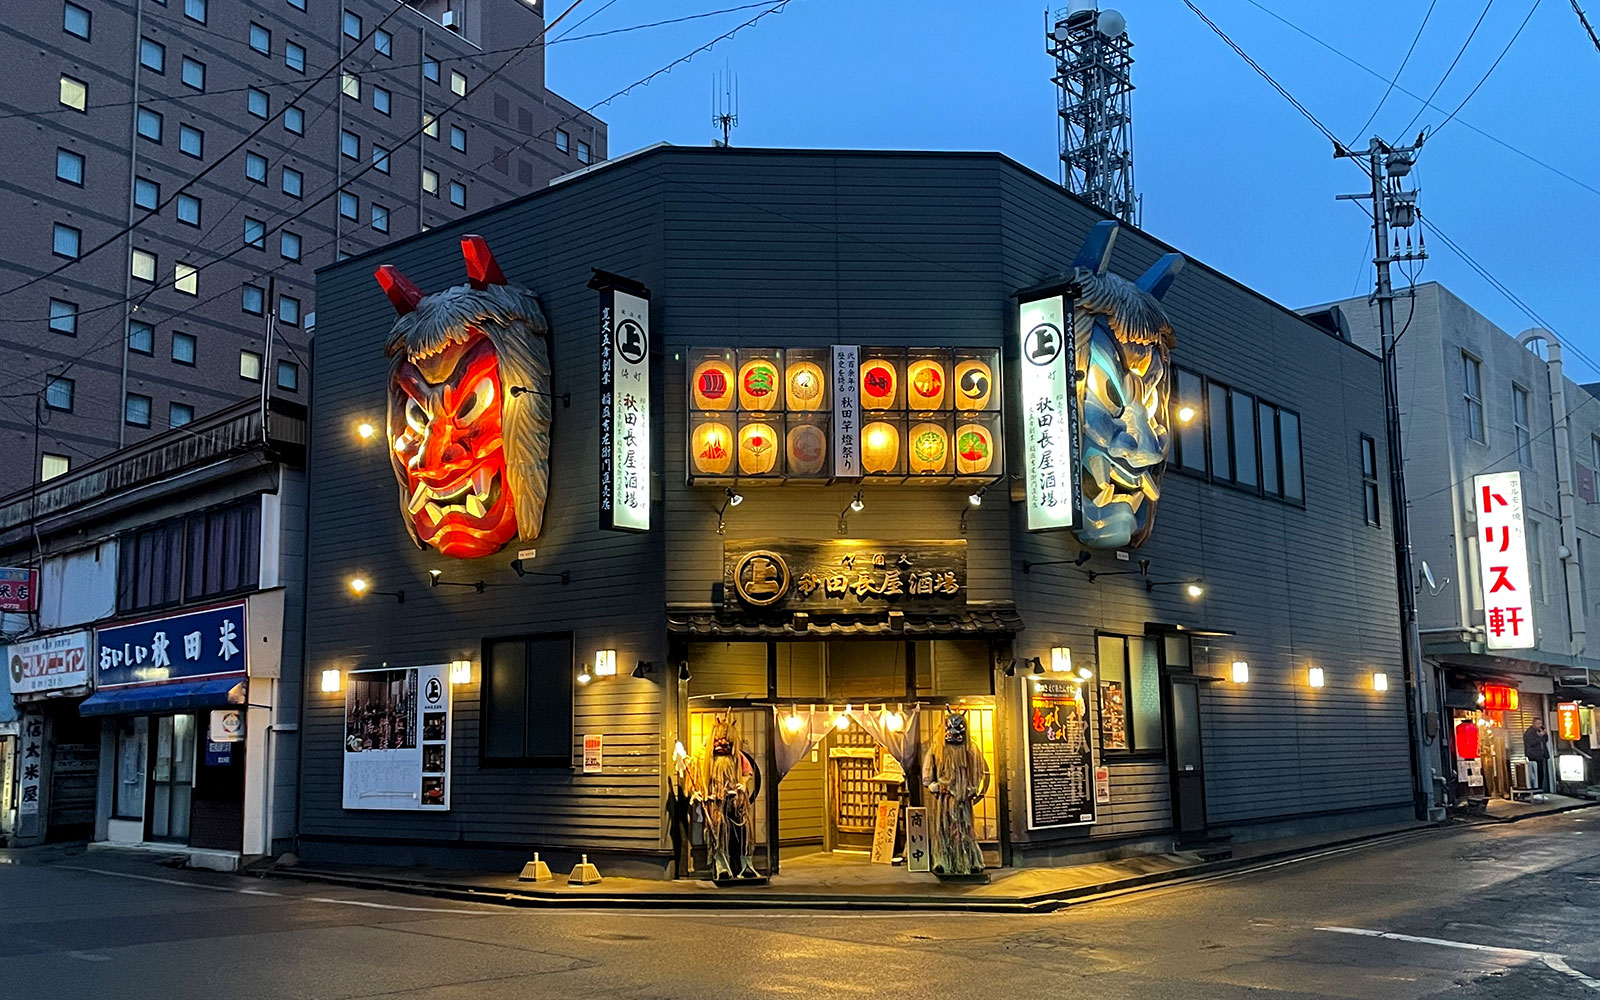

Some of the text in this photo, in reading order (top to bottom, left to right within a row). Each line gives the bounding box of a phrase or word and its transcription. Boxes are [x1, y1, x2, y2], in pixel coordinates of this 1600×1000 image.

[623, 392, 639, 509] 秋田長屋酒場
[1036, 396, 1058, 508] 秋田長屋酒場
[798, 570, 960, 603] 秋田長屋酒場
[1481, 485, 1525, 638] トリス軒
[22, 648, 86, 678] マルクニコイン
[23, 718, 43, 803] 信太米屋
[911, 812, 925, 863] 商い中
